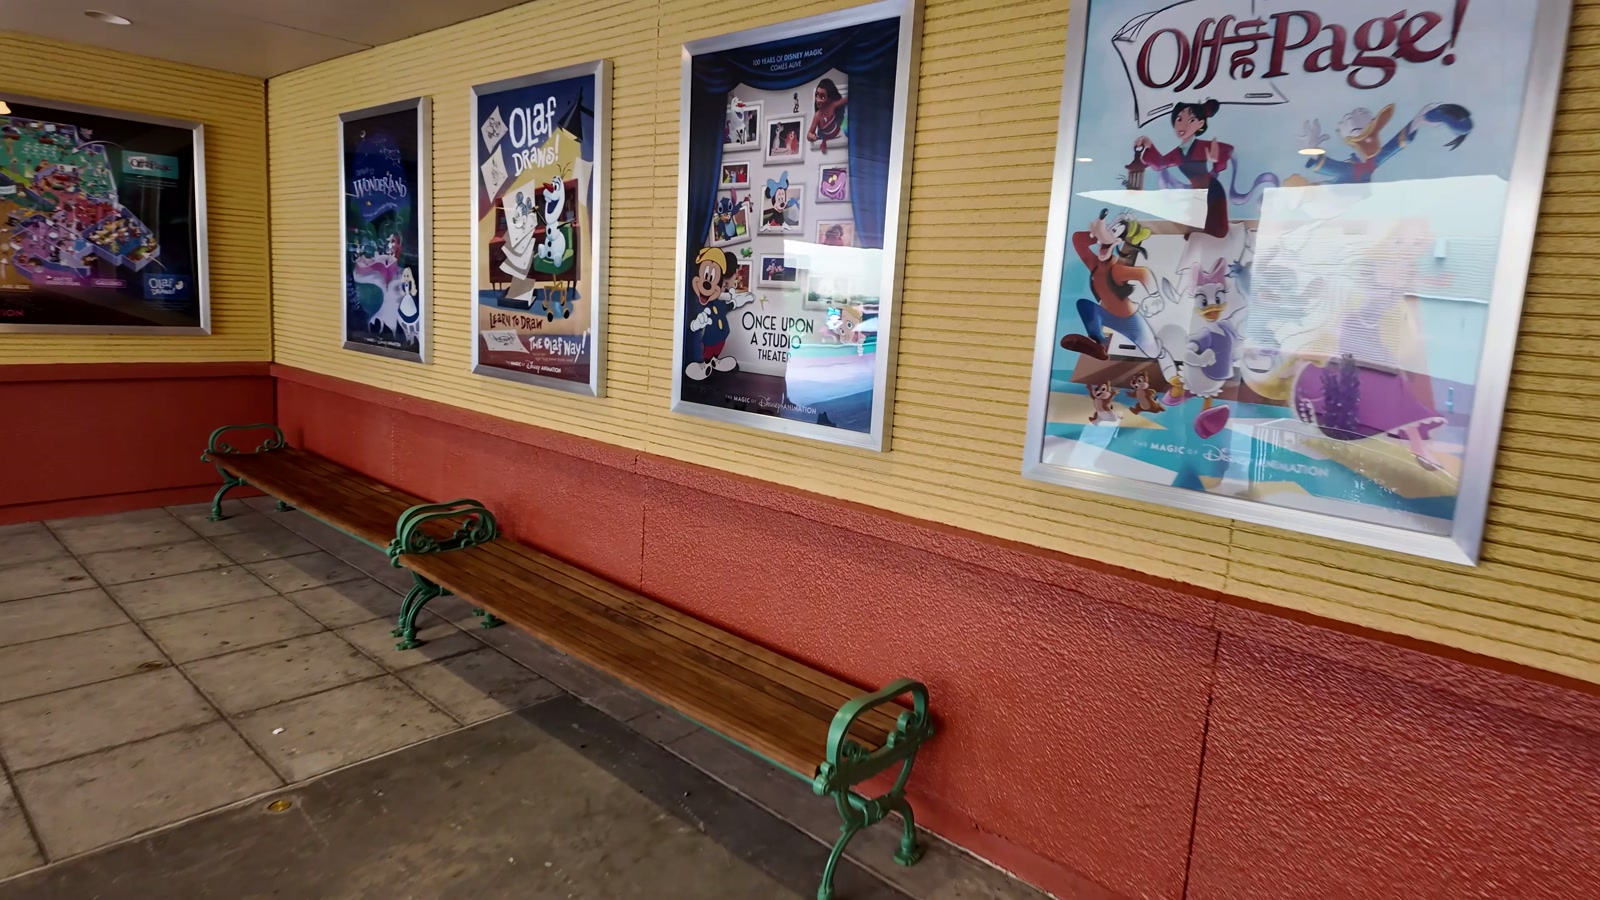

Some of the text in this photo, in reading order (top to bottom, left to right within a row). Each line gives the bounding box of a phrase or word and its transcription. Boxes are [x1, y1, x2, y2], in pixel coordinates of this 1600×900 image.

[1136, 14, 1236, 93] Off
[1260, 0, 1470, 90] Page!
[761, 56, 776, 65] YEARS
[776, 55, 784, 63] OF
[784, 51, 804, 61] DISNEY
[804, 48, 823, 57] MAGIC
[770, 60, 802, 72] COMES ALIVE
[352, 173, 407, 200] WONDERLAND
[781, 316, 814, 334] UPON
[750, 331, 802, 350] A STUDIO
[733, 395, 751, 404] MAGIC
[782, 403, 817, 415] ANIMATION
[1150, 442, 1186, 454] MAGIC
